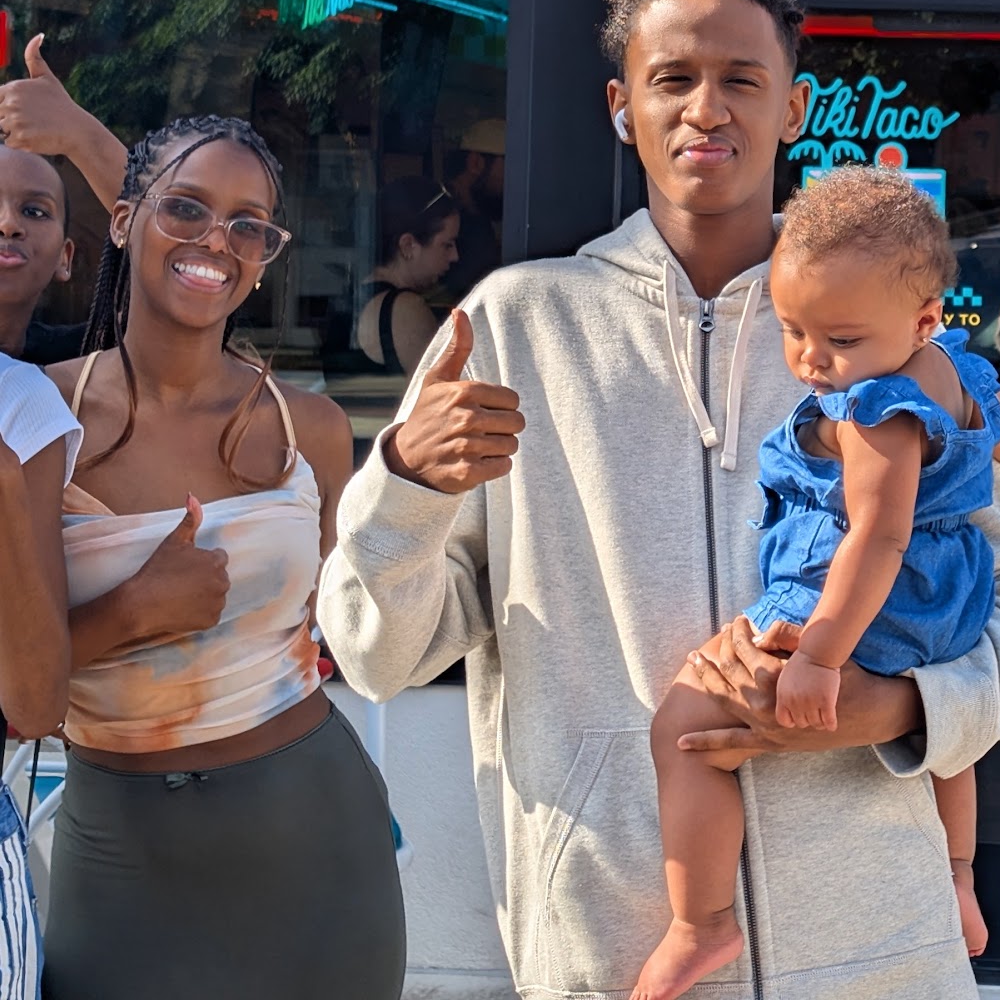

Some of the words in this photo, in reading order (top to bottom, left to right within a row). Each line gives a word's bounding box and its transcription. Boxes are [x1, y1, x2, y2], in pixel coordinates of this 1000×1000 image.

[795, 72, 860, 138] Tiki
[857, 75, 961, 140] Taco
[958, 313, 982, 326] TO
